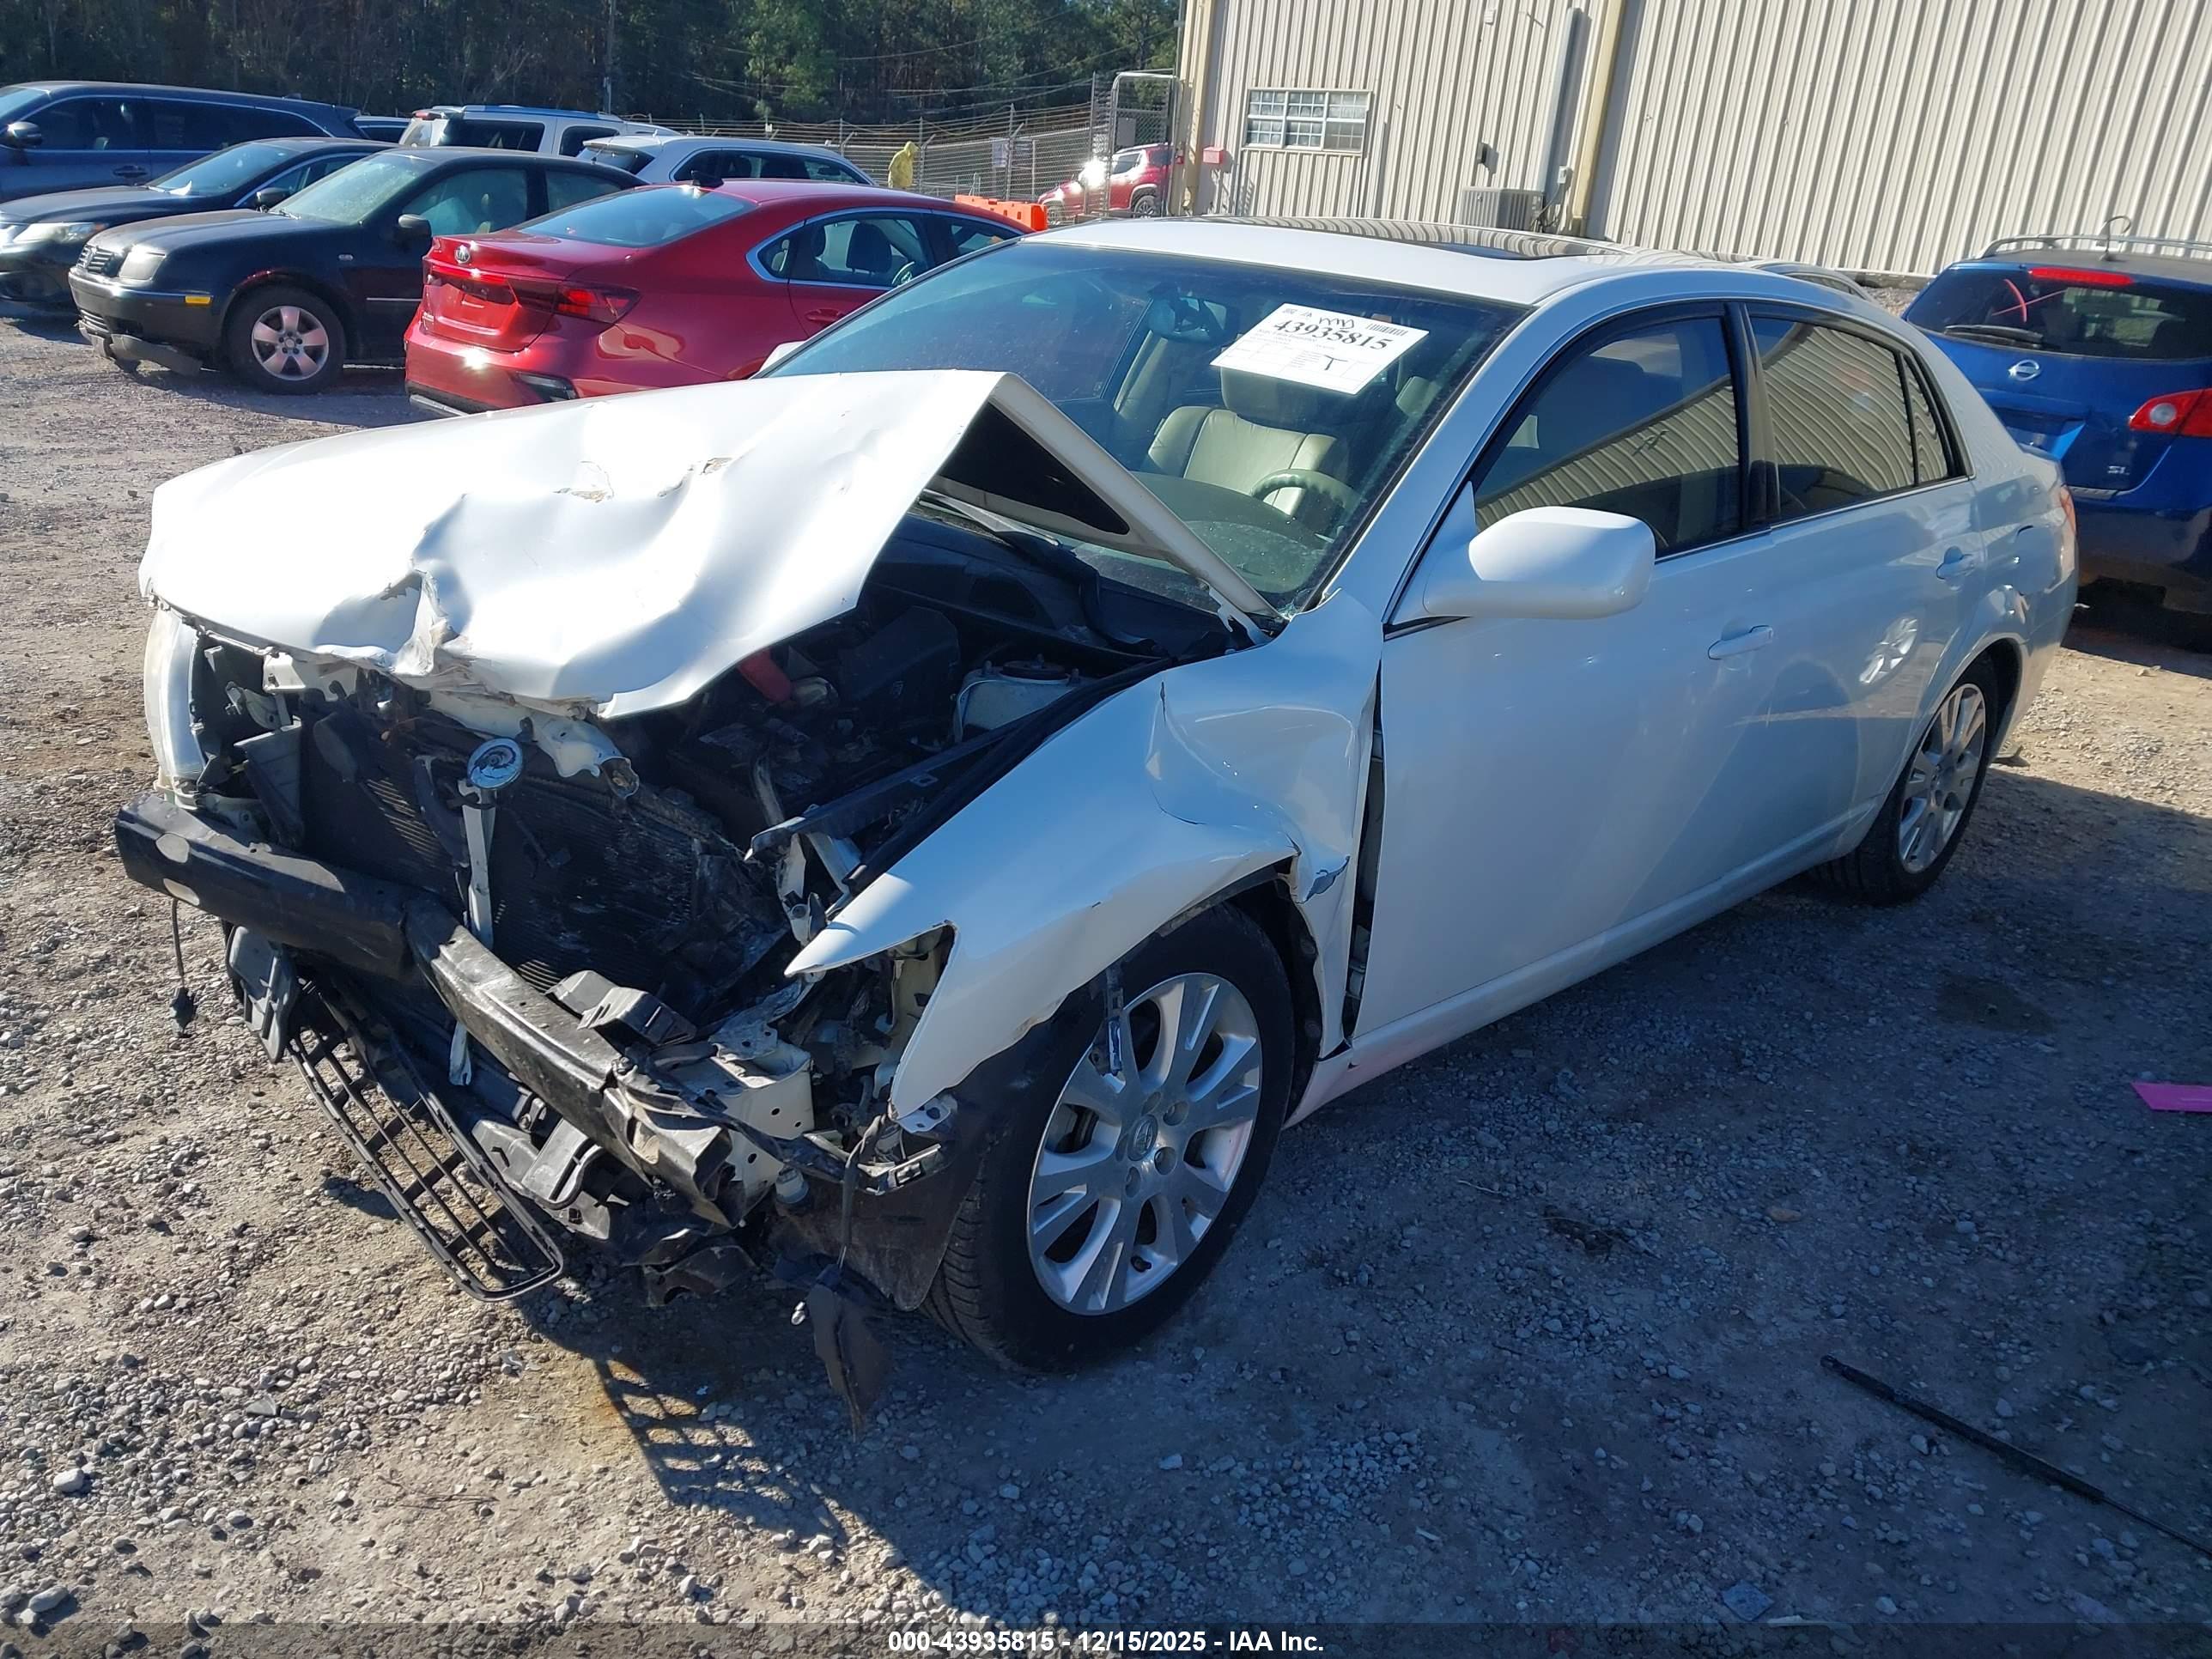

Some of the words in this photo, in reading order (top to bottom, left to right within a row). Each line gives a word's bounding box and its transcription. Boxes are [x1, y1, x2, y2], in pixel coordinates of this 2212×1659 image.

[1274, 320, 1394, 349] 43935815
[1324, 354, 1348, 371] T
[2107, 465, 2130, 476] SL
